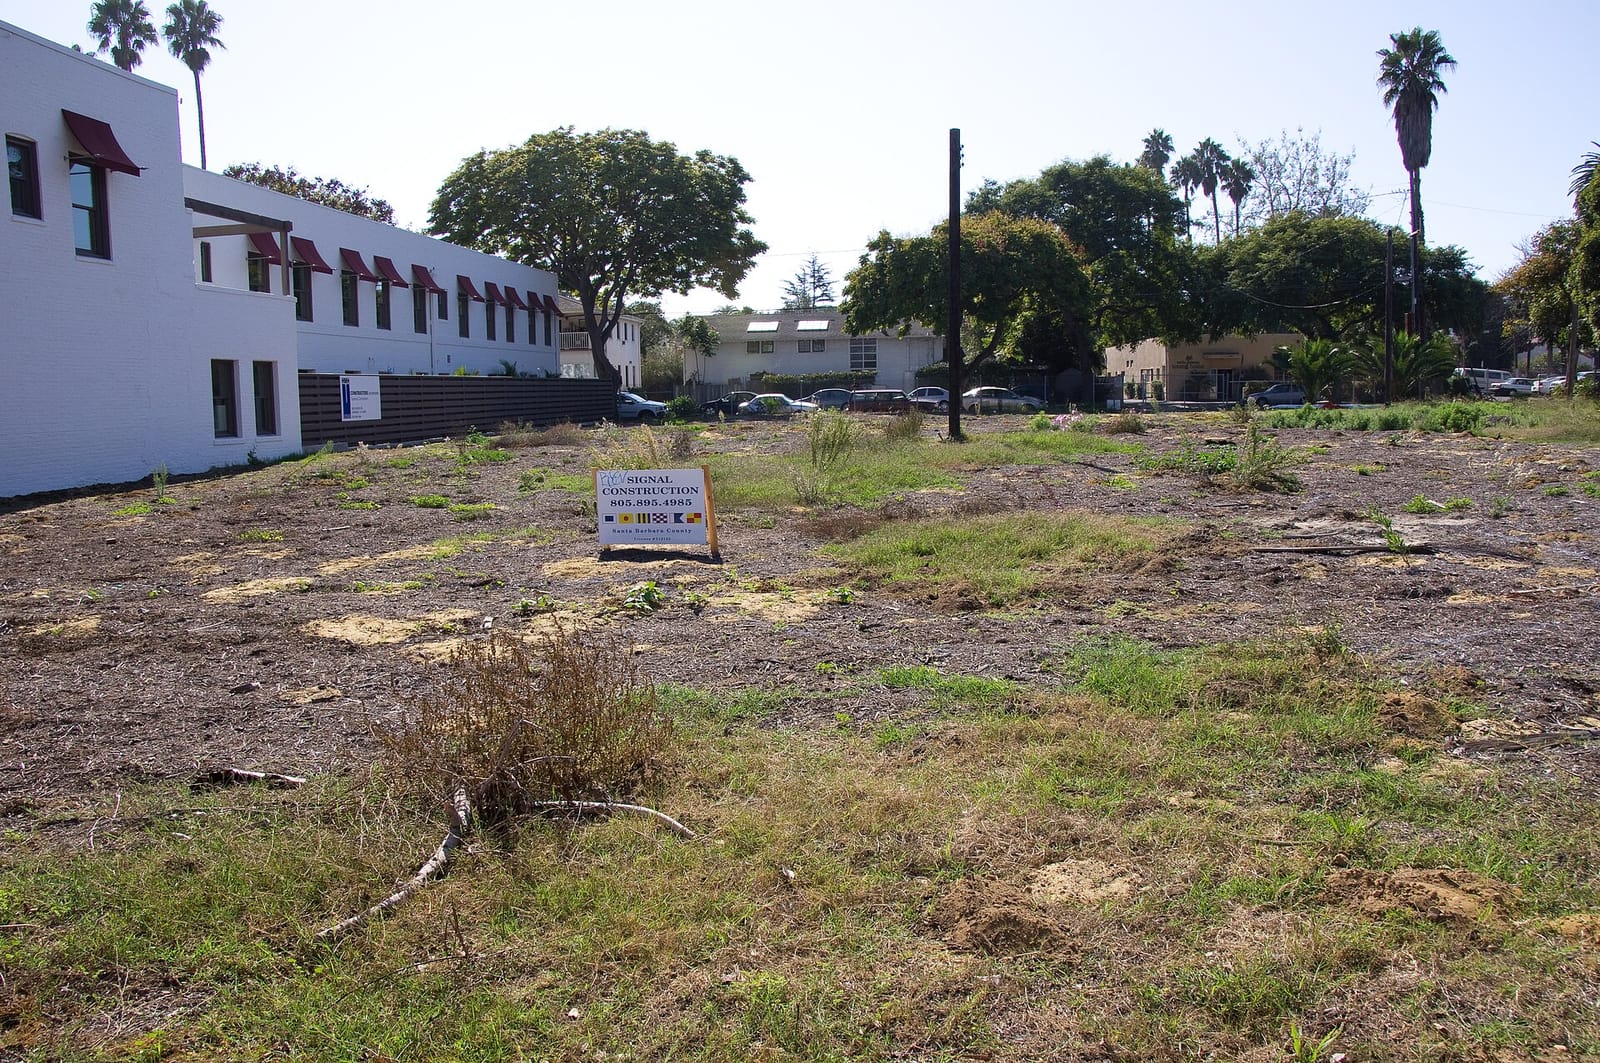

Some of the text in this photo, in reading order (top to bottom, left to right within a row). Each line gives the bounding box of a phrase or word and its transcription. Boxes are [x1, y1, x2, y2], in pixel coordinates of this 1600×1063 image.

[627, 475, 673, 484] SIGNAL
[602, 486, 699, 496] CONSTRUCTION
[610, 498, 692, 507] 805.895.4985
